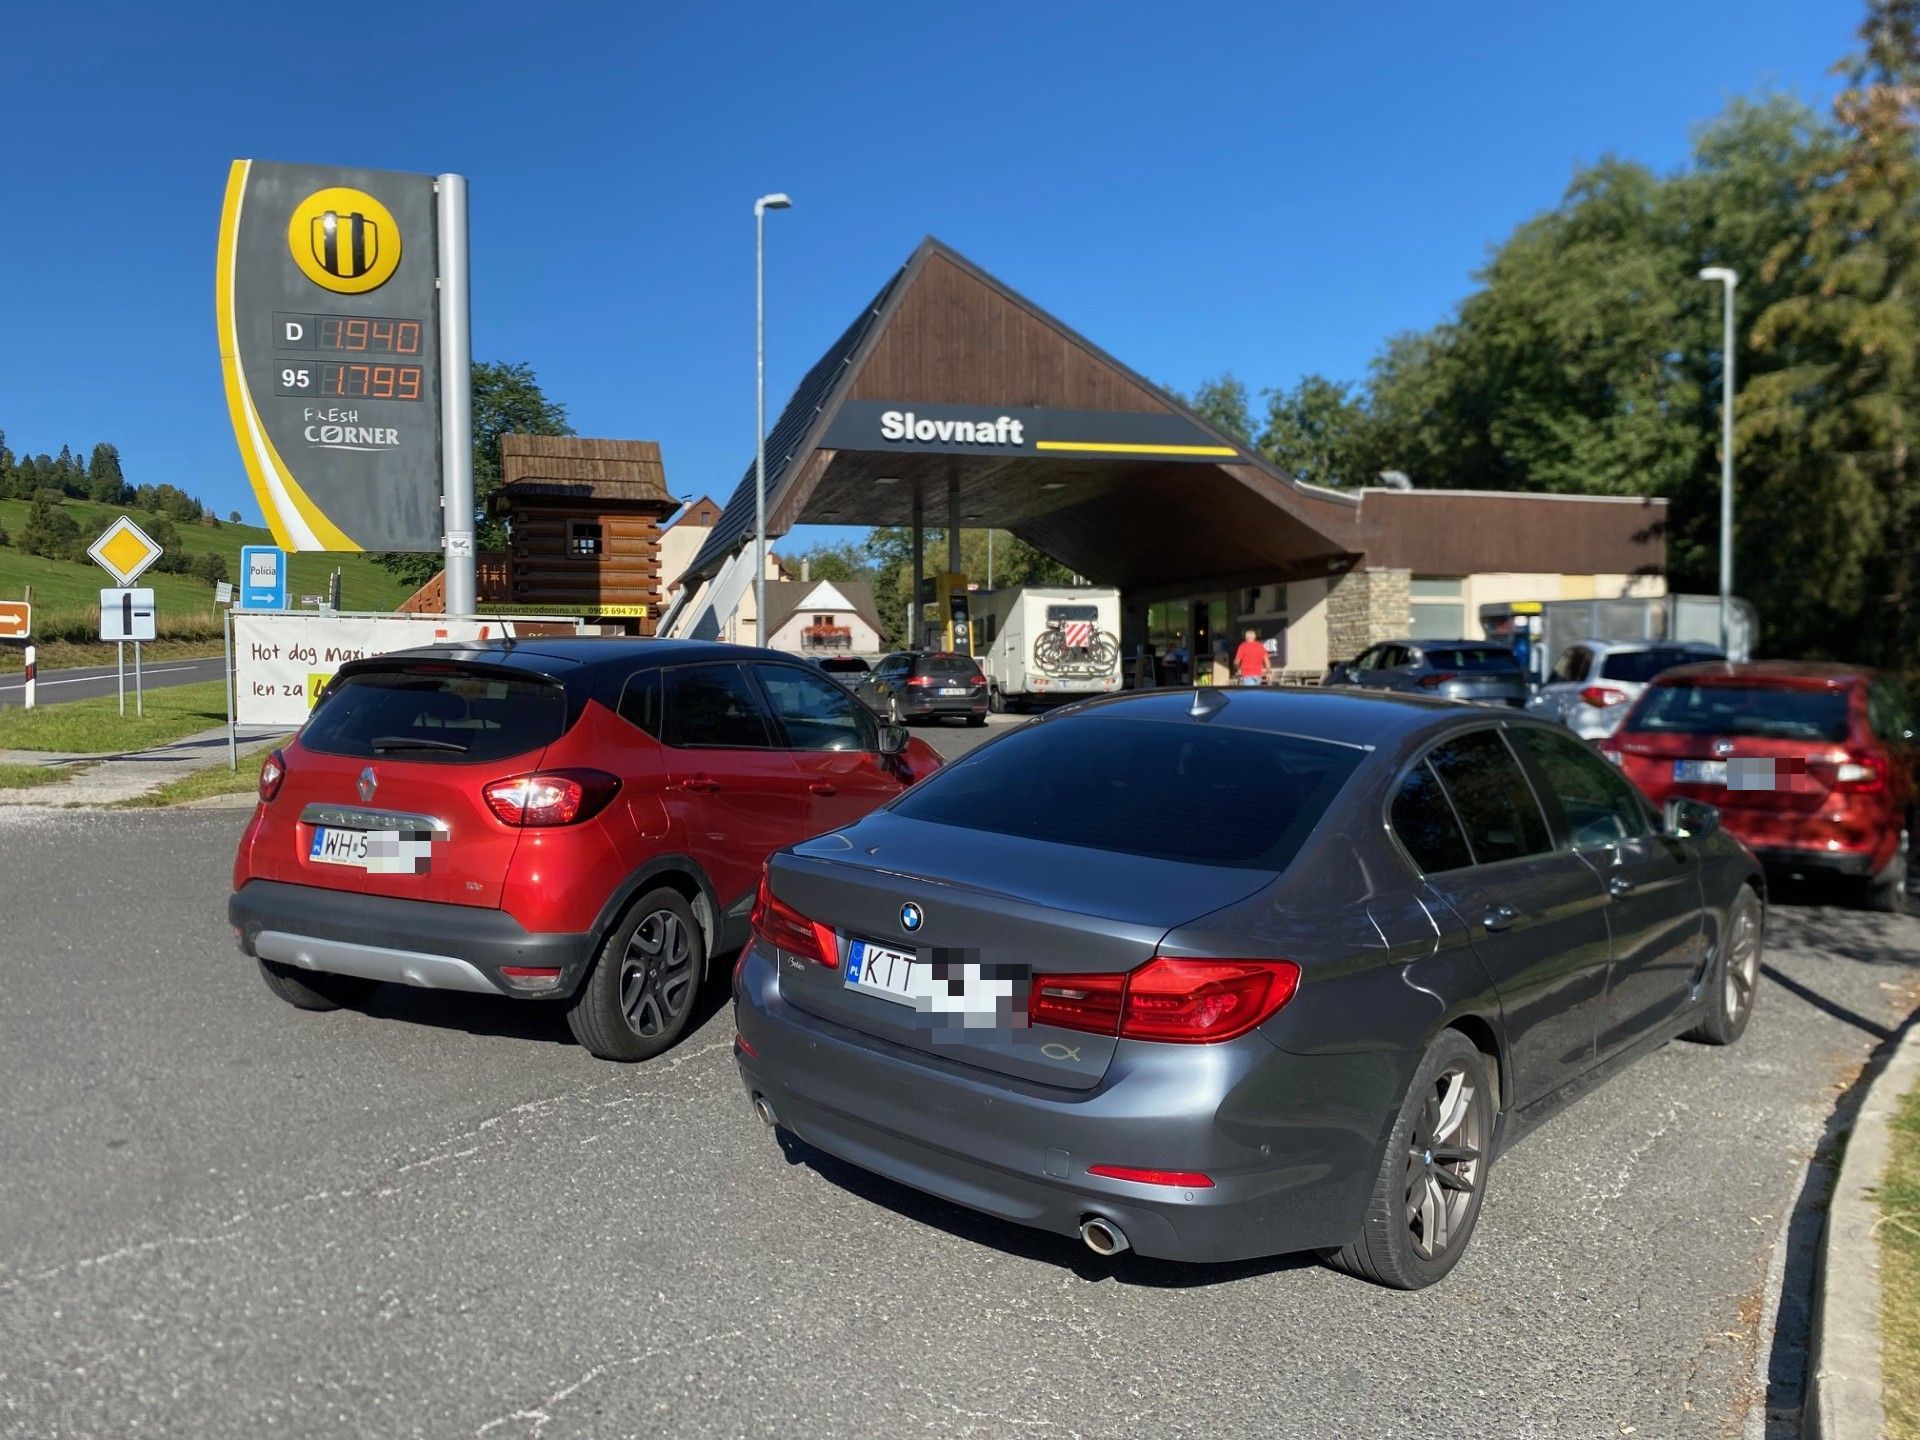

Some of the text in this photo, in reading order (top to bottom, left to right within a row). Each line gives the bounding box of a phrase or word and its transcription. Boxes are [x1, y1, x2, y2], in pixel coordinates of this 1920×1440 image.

[286, 322, 304, 341] D
[281, 369, 311, 388] 95
[881, 410, 1024, 445] Slovnaft
[588, 606, 609, 615] 0905
[610, 607, 627, 615] 694
[628, 607, 644, 616] 797
[251, 642, 365, 666] Hot dog Maxi
[252, 680, 275, 697] len
[282, 683, 303, 697] za
[849, 965, 859, 977] PL
